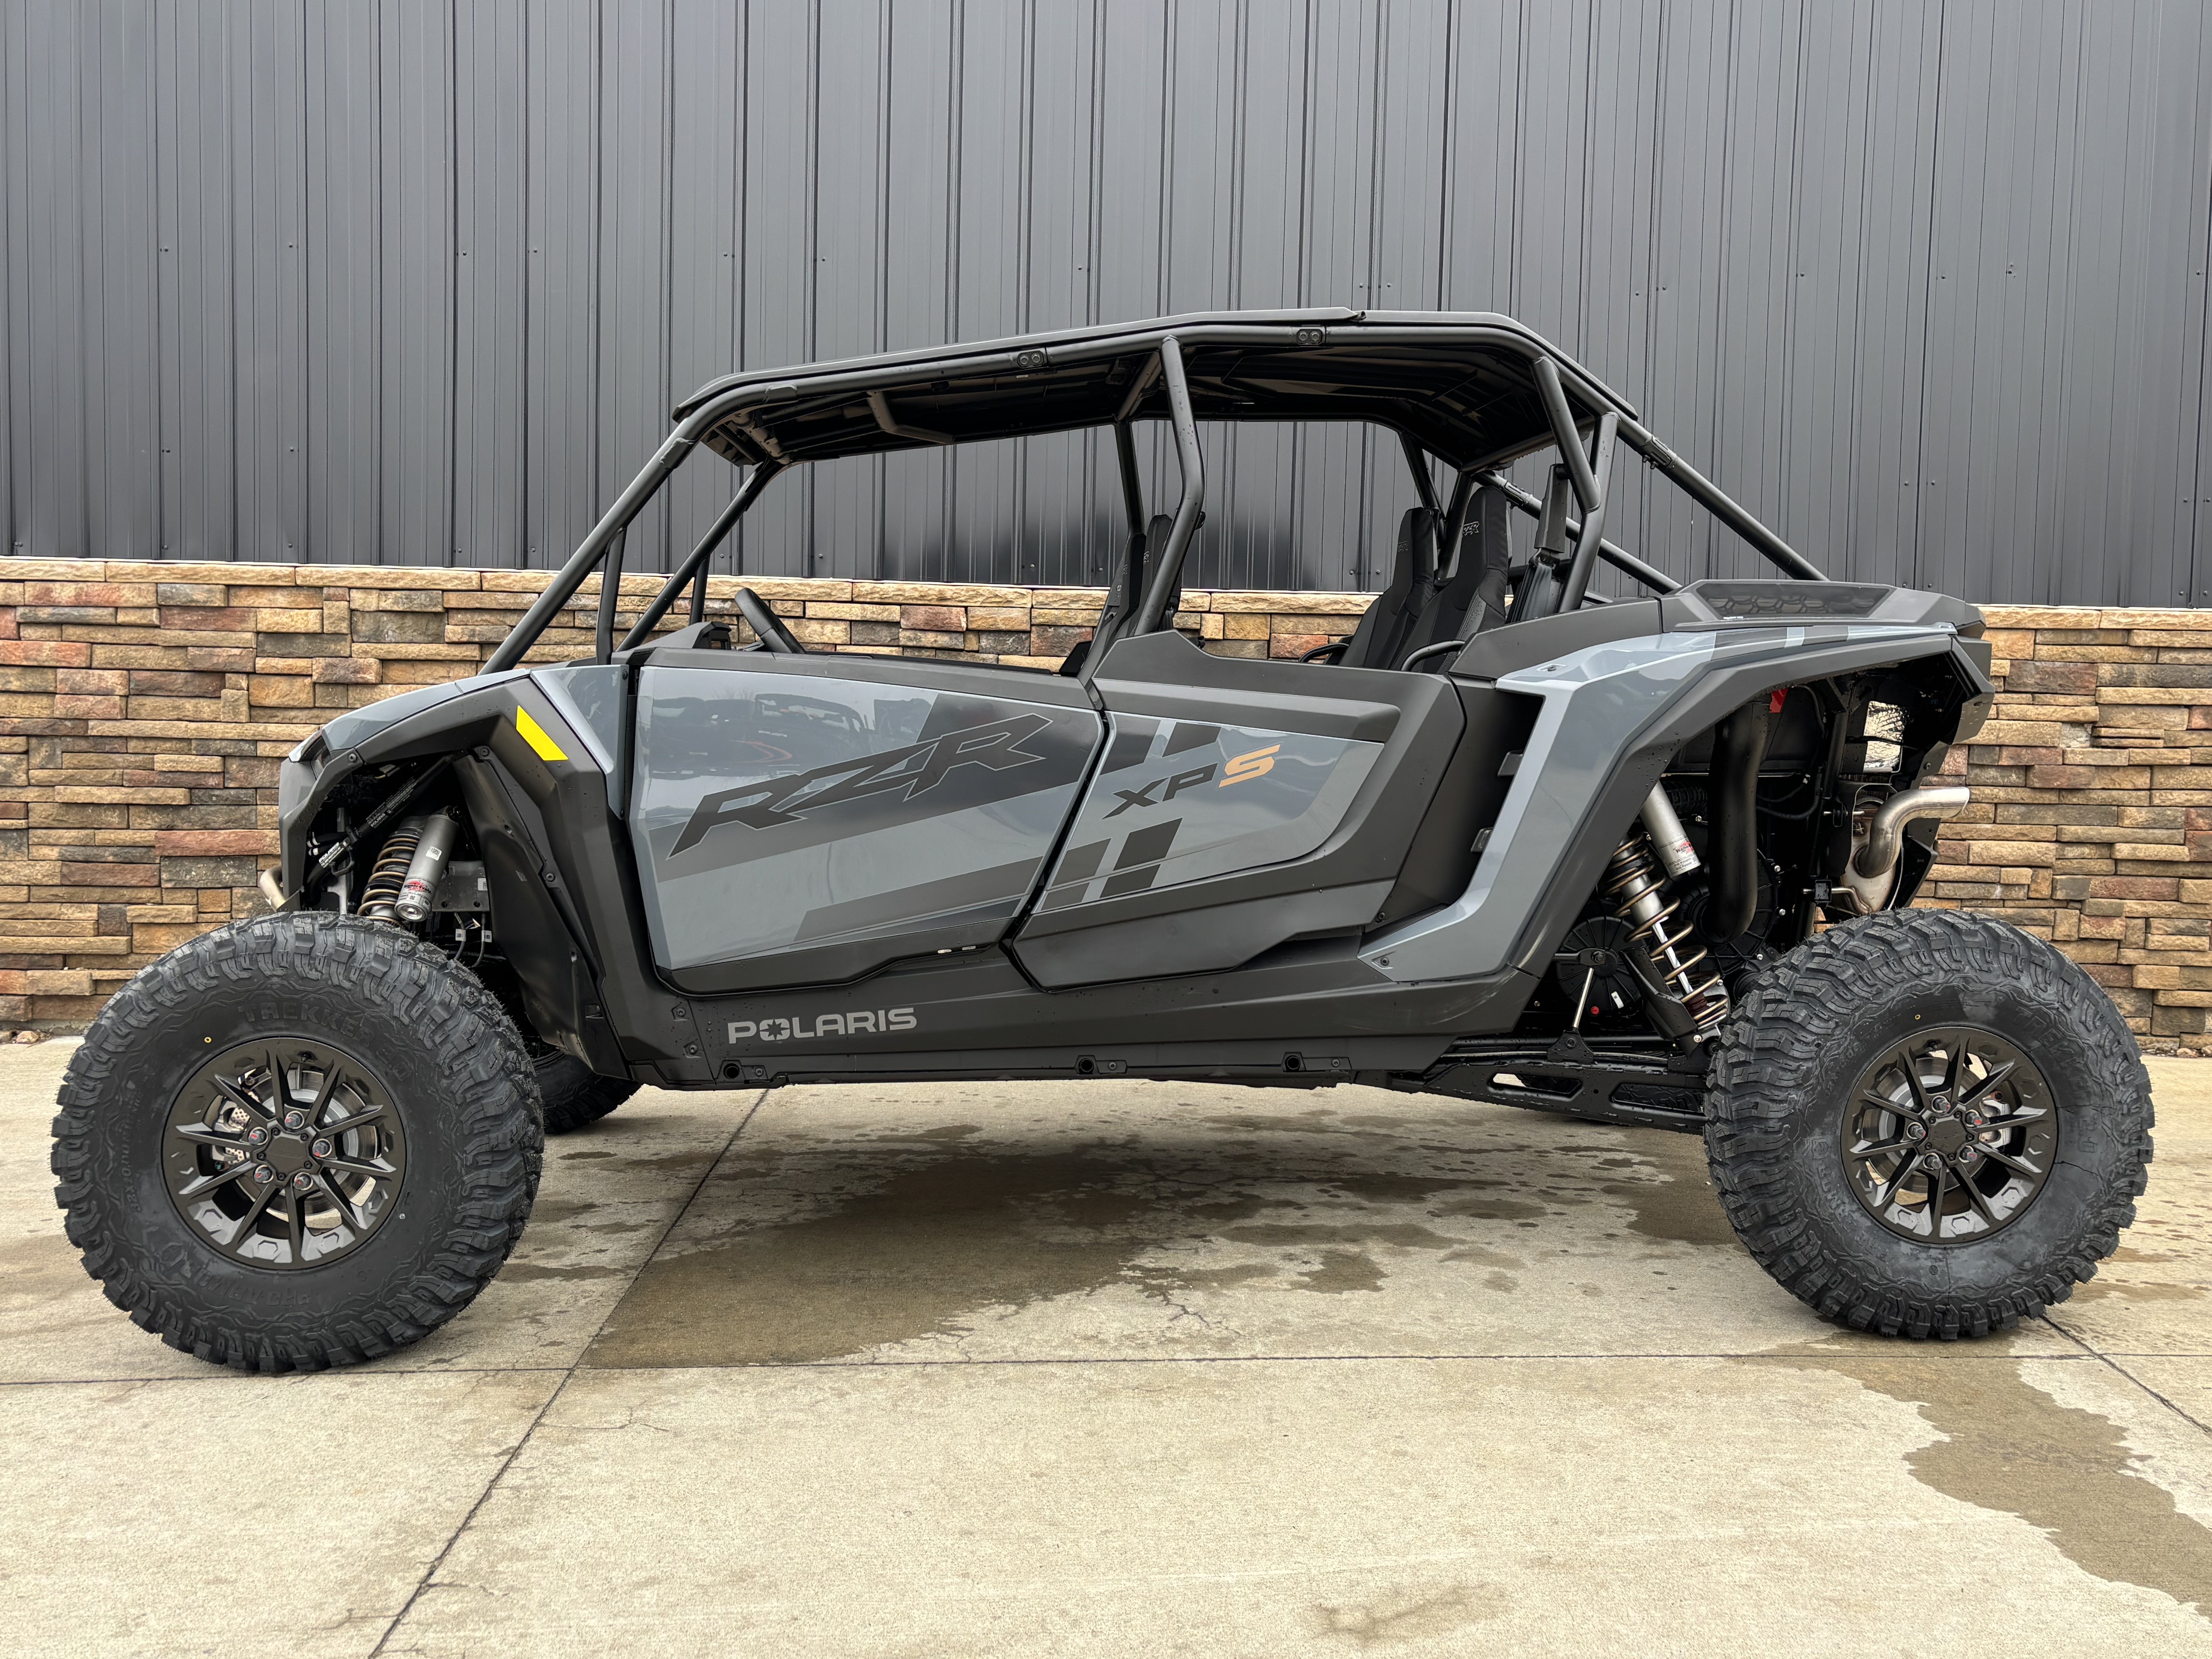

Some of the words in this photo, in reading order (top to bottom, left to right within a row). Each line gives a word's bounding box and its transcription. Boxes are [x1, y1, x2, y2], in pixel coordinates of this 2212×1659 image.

[666, 713, 1053, 860] RZR
[237, 1002, 374, 1047] TREKKER
[728, 1008, 917, 1044] POLARIS
